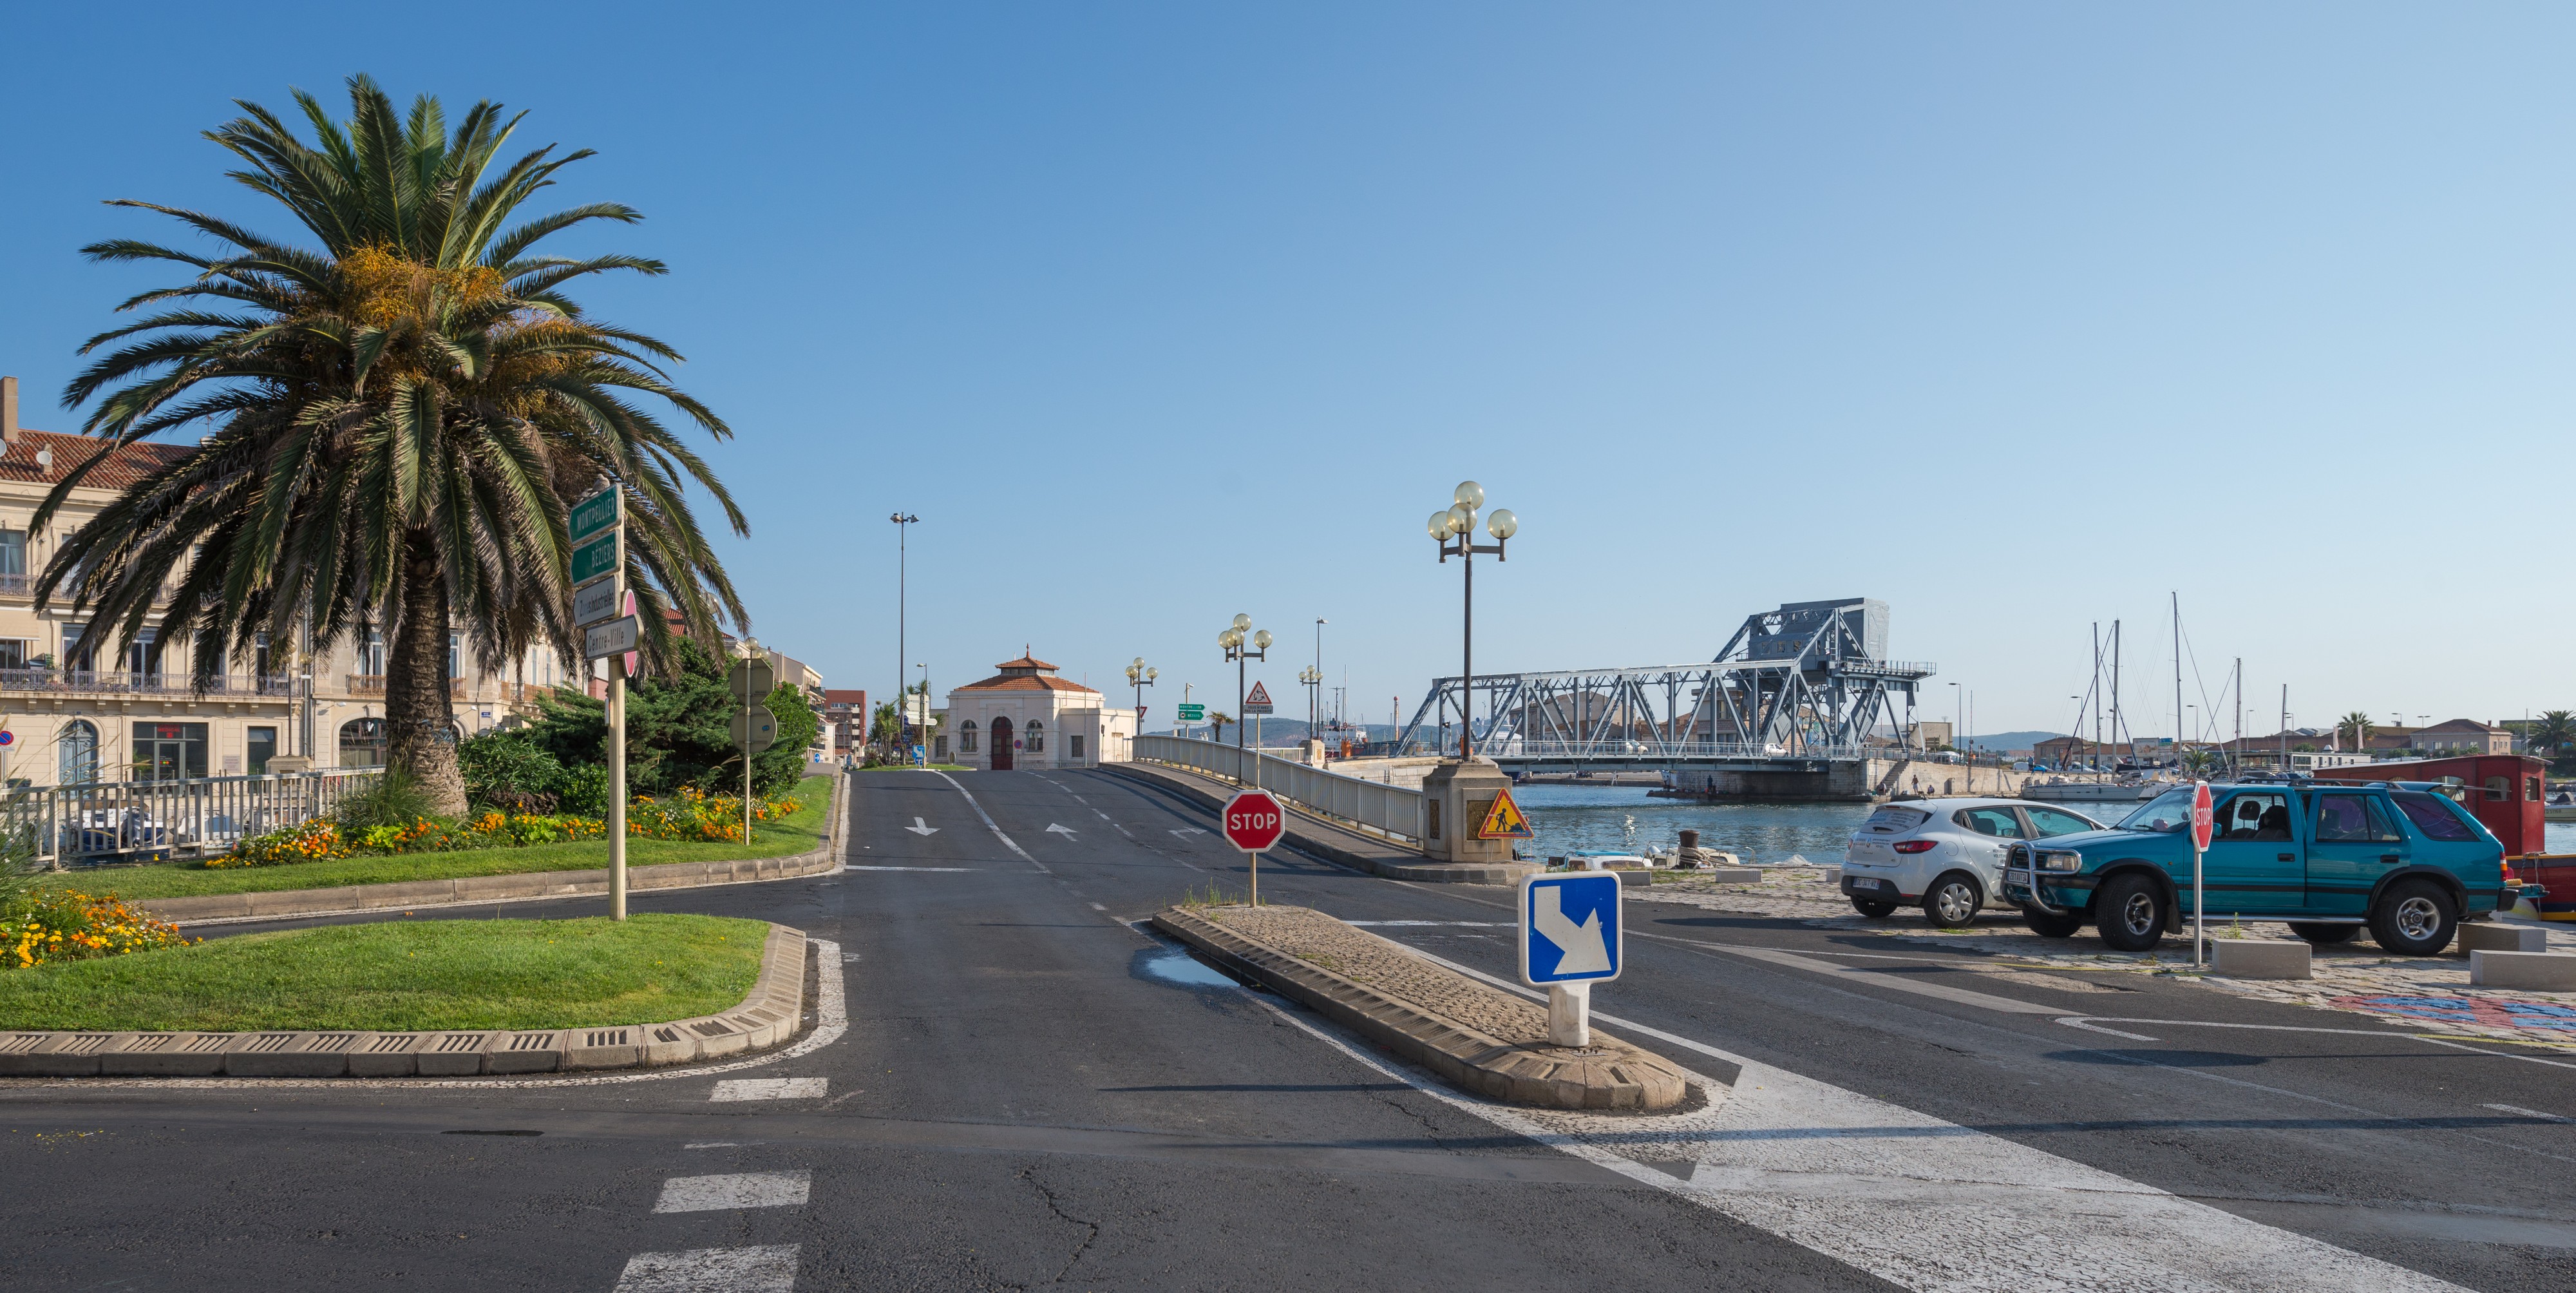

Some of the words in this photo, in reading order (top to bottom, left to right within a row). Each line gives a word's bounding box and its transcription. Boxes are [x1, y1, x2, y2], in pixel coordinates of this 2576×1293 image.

[577, 497, 615, 532] MONTPELLIER
[592, 542, 614, 568] BÉZIERS
[591, 589, 614, 613] Industrielles
[588, 627, 624, 652] Centre-Ville
[1231, 813, 1276, 830] STOP
[2197, 807, 2211, 827] STOP
